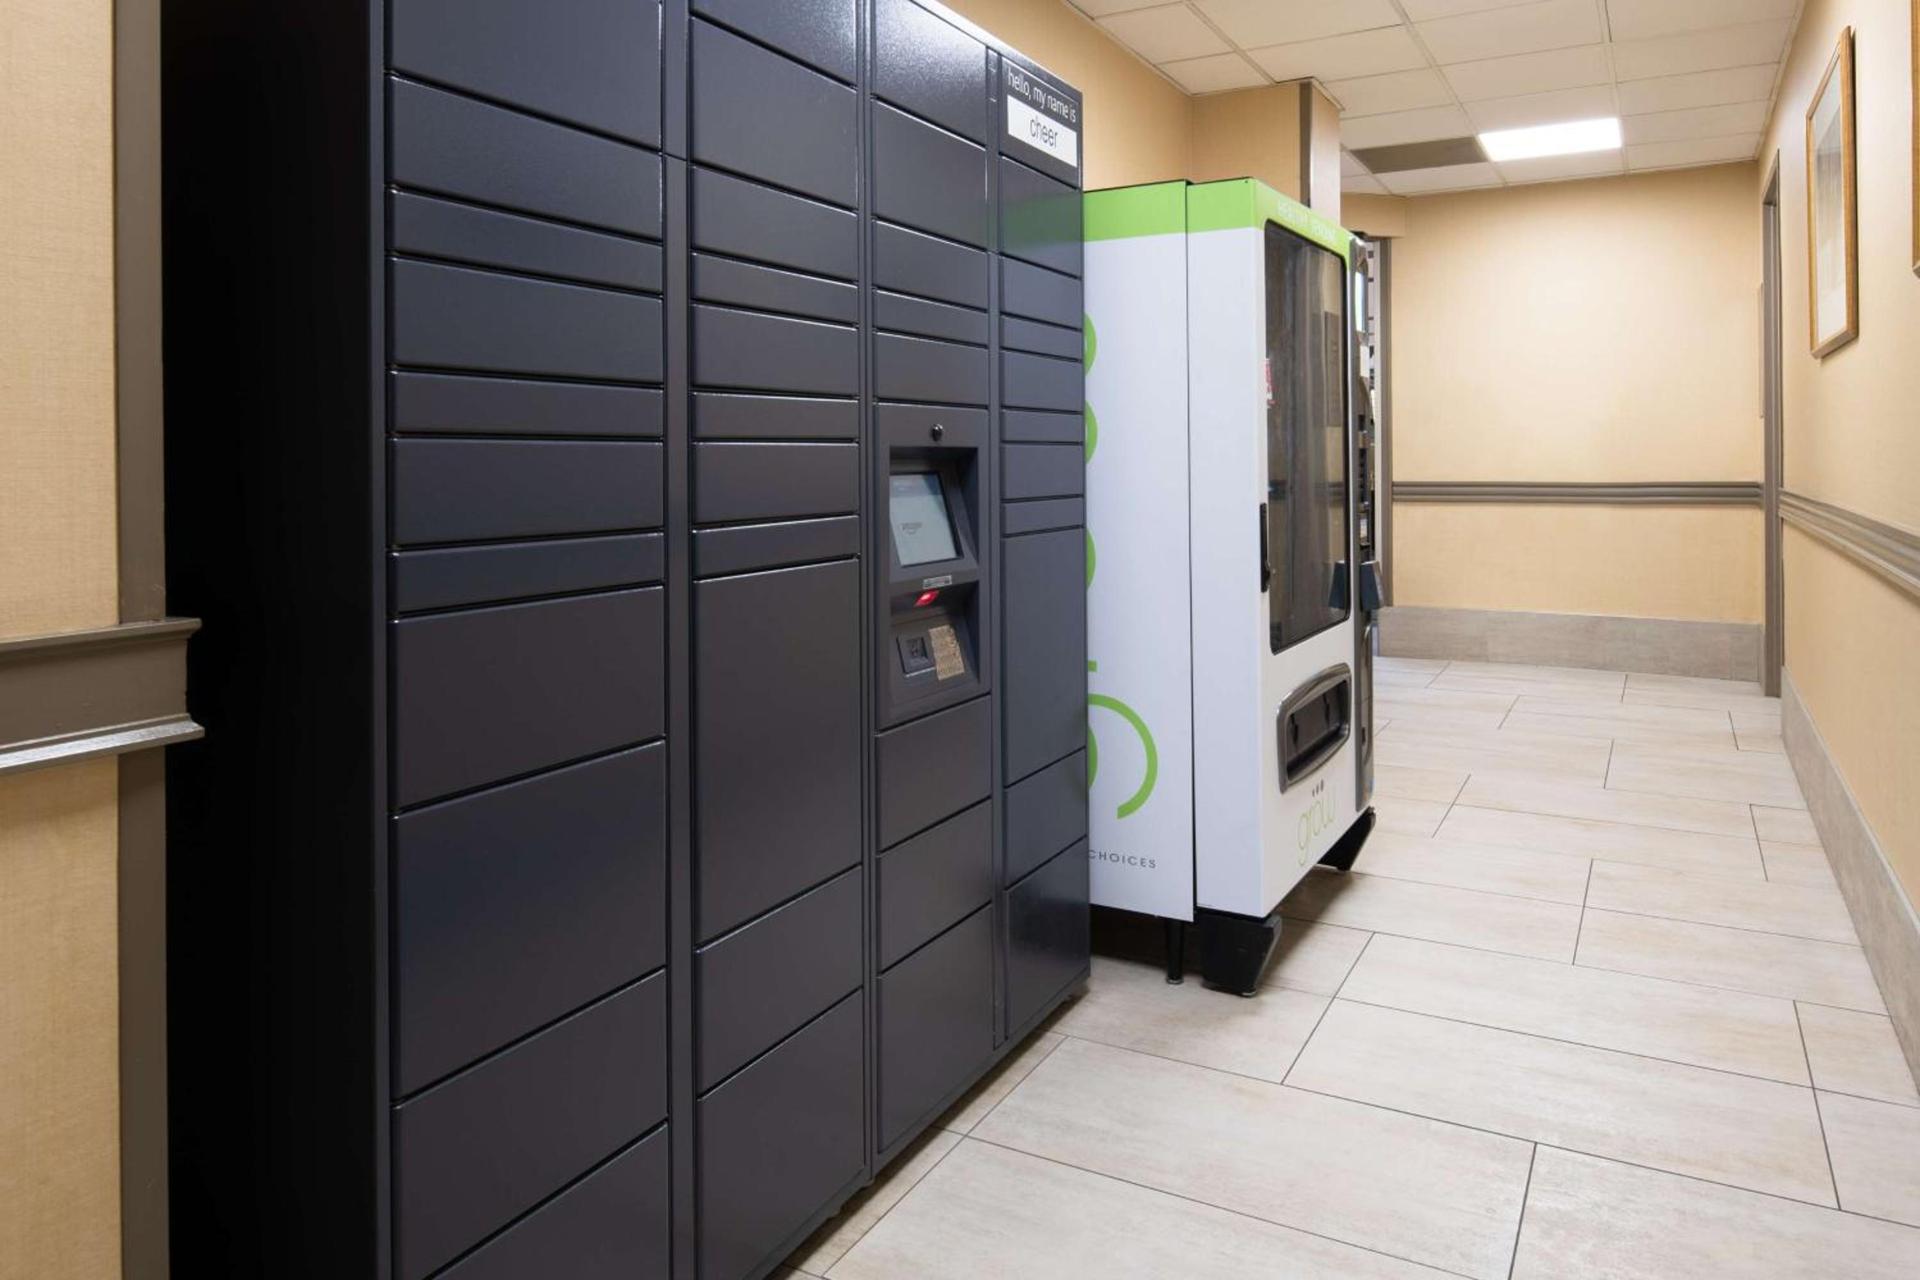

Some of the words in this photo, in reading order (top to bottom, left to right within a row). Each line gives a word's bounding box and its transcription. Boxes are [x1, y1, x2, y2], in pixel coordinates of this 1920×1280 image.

[1008, 67, 1032, 100] hello,
[1033, 87, 1046, 109] my
[1047, 95, 1068, 118] name
[1069, 104, 1076, 122] is
[1030, 115, 1058, 147] cheer
[1088, 850, 1156, 869] CHOICES
